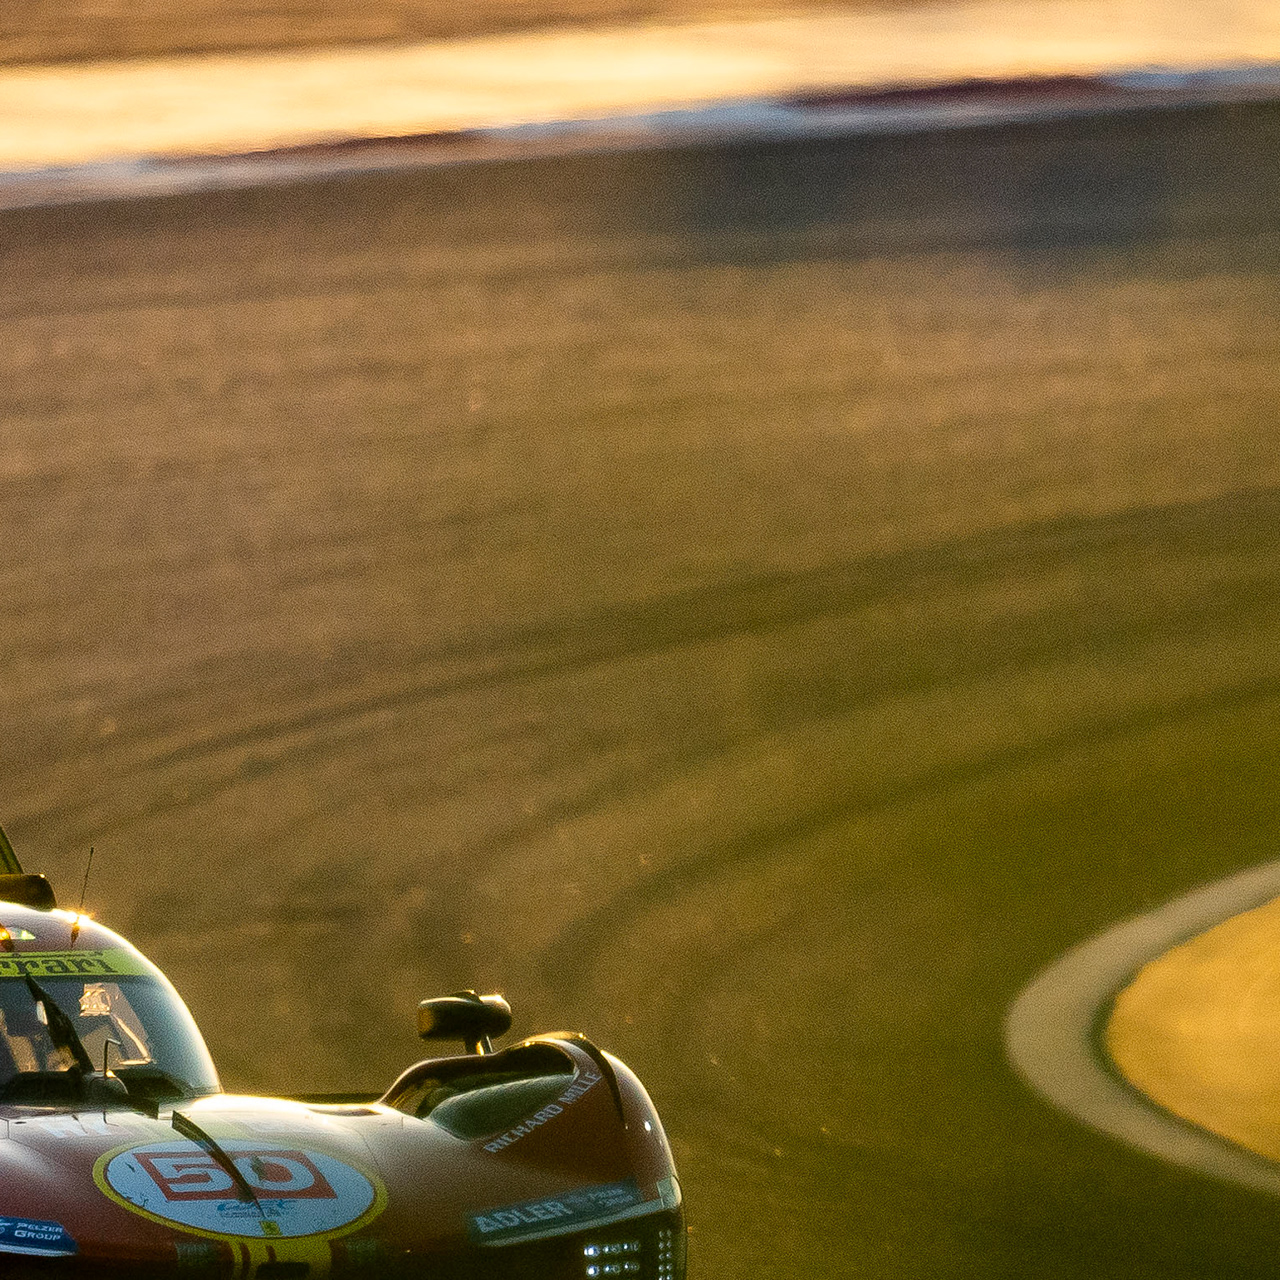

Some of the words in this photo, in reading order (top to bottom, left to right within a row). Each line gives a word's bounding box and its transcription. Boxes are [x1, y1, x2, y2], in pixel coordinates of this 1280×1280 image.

[483, 1104, 564, 1153] RICHARD
[559, 1071, 603, 1104] MILLE
[149, 1156, 315, 1193] 50
[16, 1222, 63, 1233] PELZER
[474, 1201, 573, 1233] ADLER
[14, 1230, 61, 1241] GROUP
